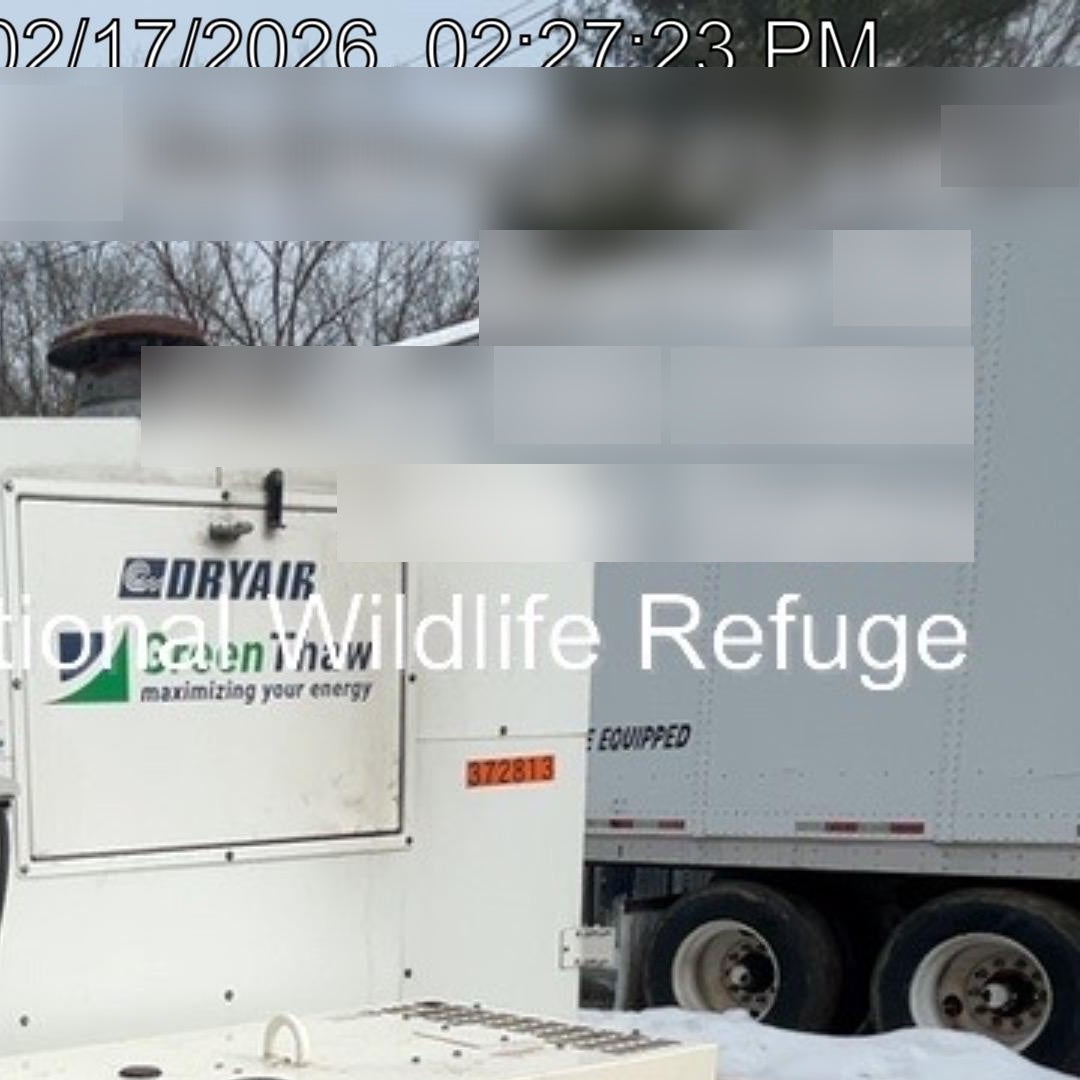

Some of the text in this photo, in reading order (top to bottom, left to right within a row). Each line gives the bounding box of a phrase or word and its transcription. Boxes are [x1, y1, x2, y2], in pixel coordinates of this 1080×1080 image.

[166, 560, 317, 601] DRYAIR
[140, 680, 373, 705] maximizing your energy
[598, 723, 692, 751] EQUIPPED
[468, 756, 553, 787] 372813
